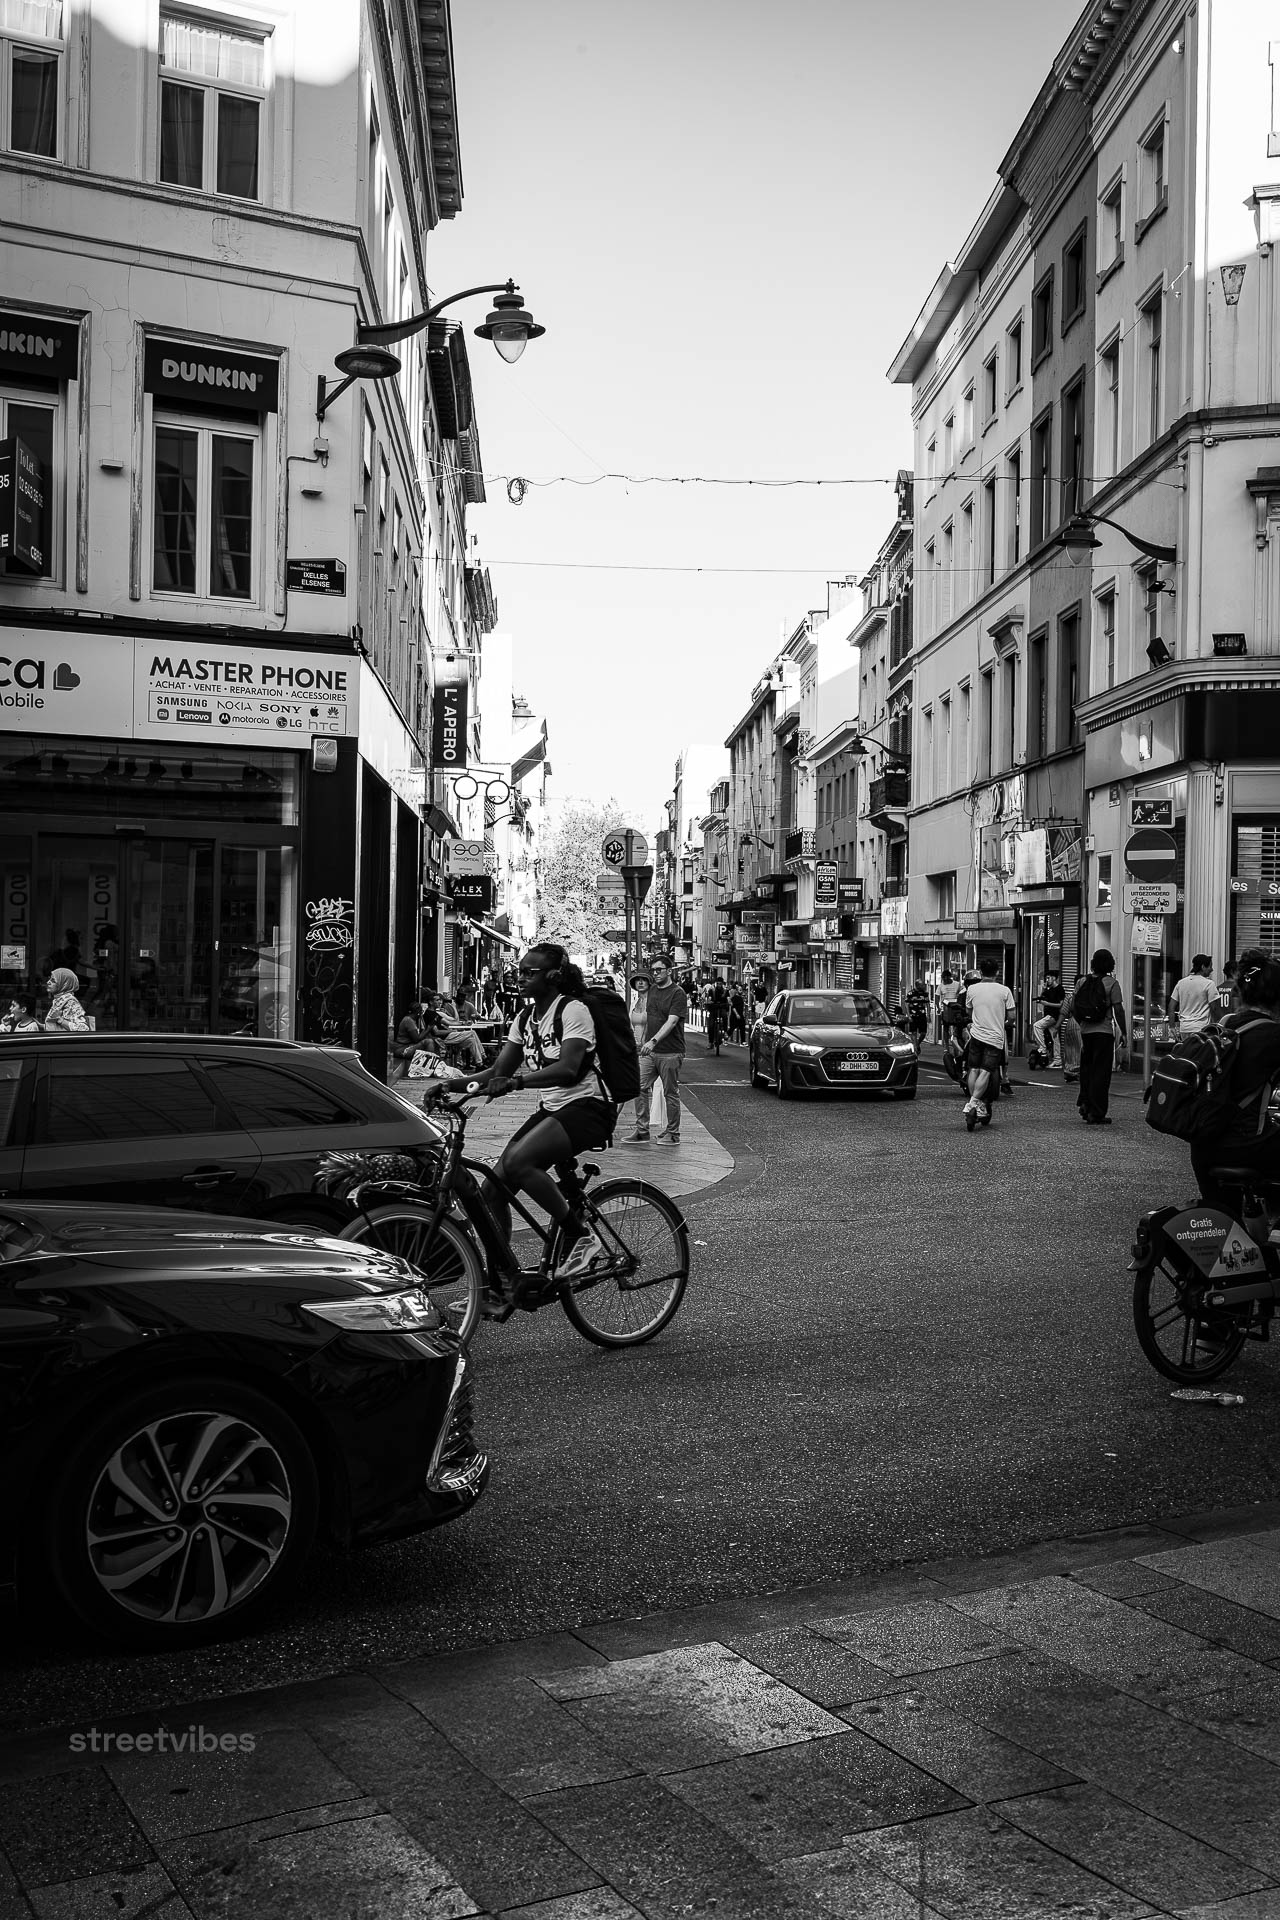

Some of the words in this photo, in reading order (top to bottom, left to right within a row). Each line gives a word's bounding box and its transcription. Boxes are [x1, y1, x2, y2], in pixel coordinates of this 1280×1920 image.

[162, 359, 264, 392] DUNKIN'
[303, 572, 329, 580] IXELLES
[149, 655, 254, 684] MASTER
[261, 664, 347, 691] PHONE
[155, 680, 187, 690] ACHAT
[193, 682, 222, 693] VENTE
[229, 685, 283, 697] REPARATION
[290, 690, 347, 702] ACCESSOIRES
[156, 695, 208, 708] SAMSUNG
[216, 700, 253, 712] NOKIA
[259, 703, 302, 714] SONY
[179, 711, 210, 721] Lenovo
[231, 715, 270, 725] motorola
[289, 718, 303, 728] LG
[453, 885, 483, 894] ALEX
[1219, 993, 1230, 1008] 10
[1190, 1217, 1213, 1228] Gratis
[1176, 1227, 1227, 1241] ontgrendelen
